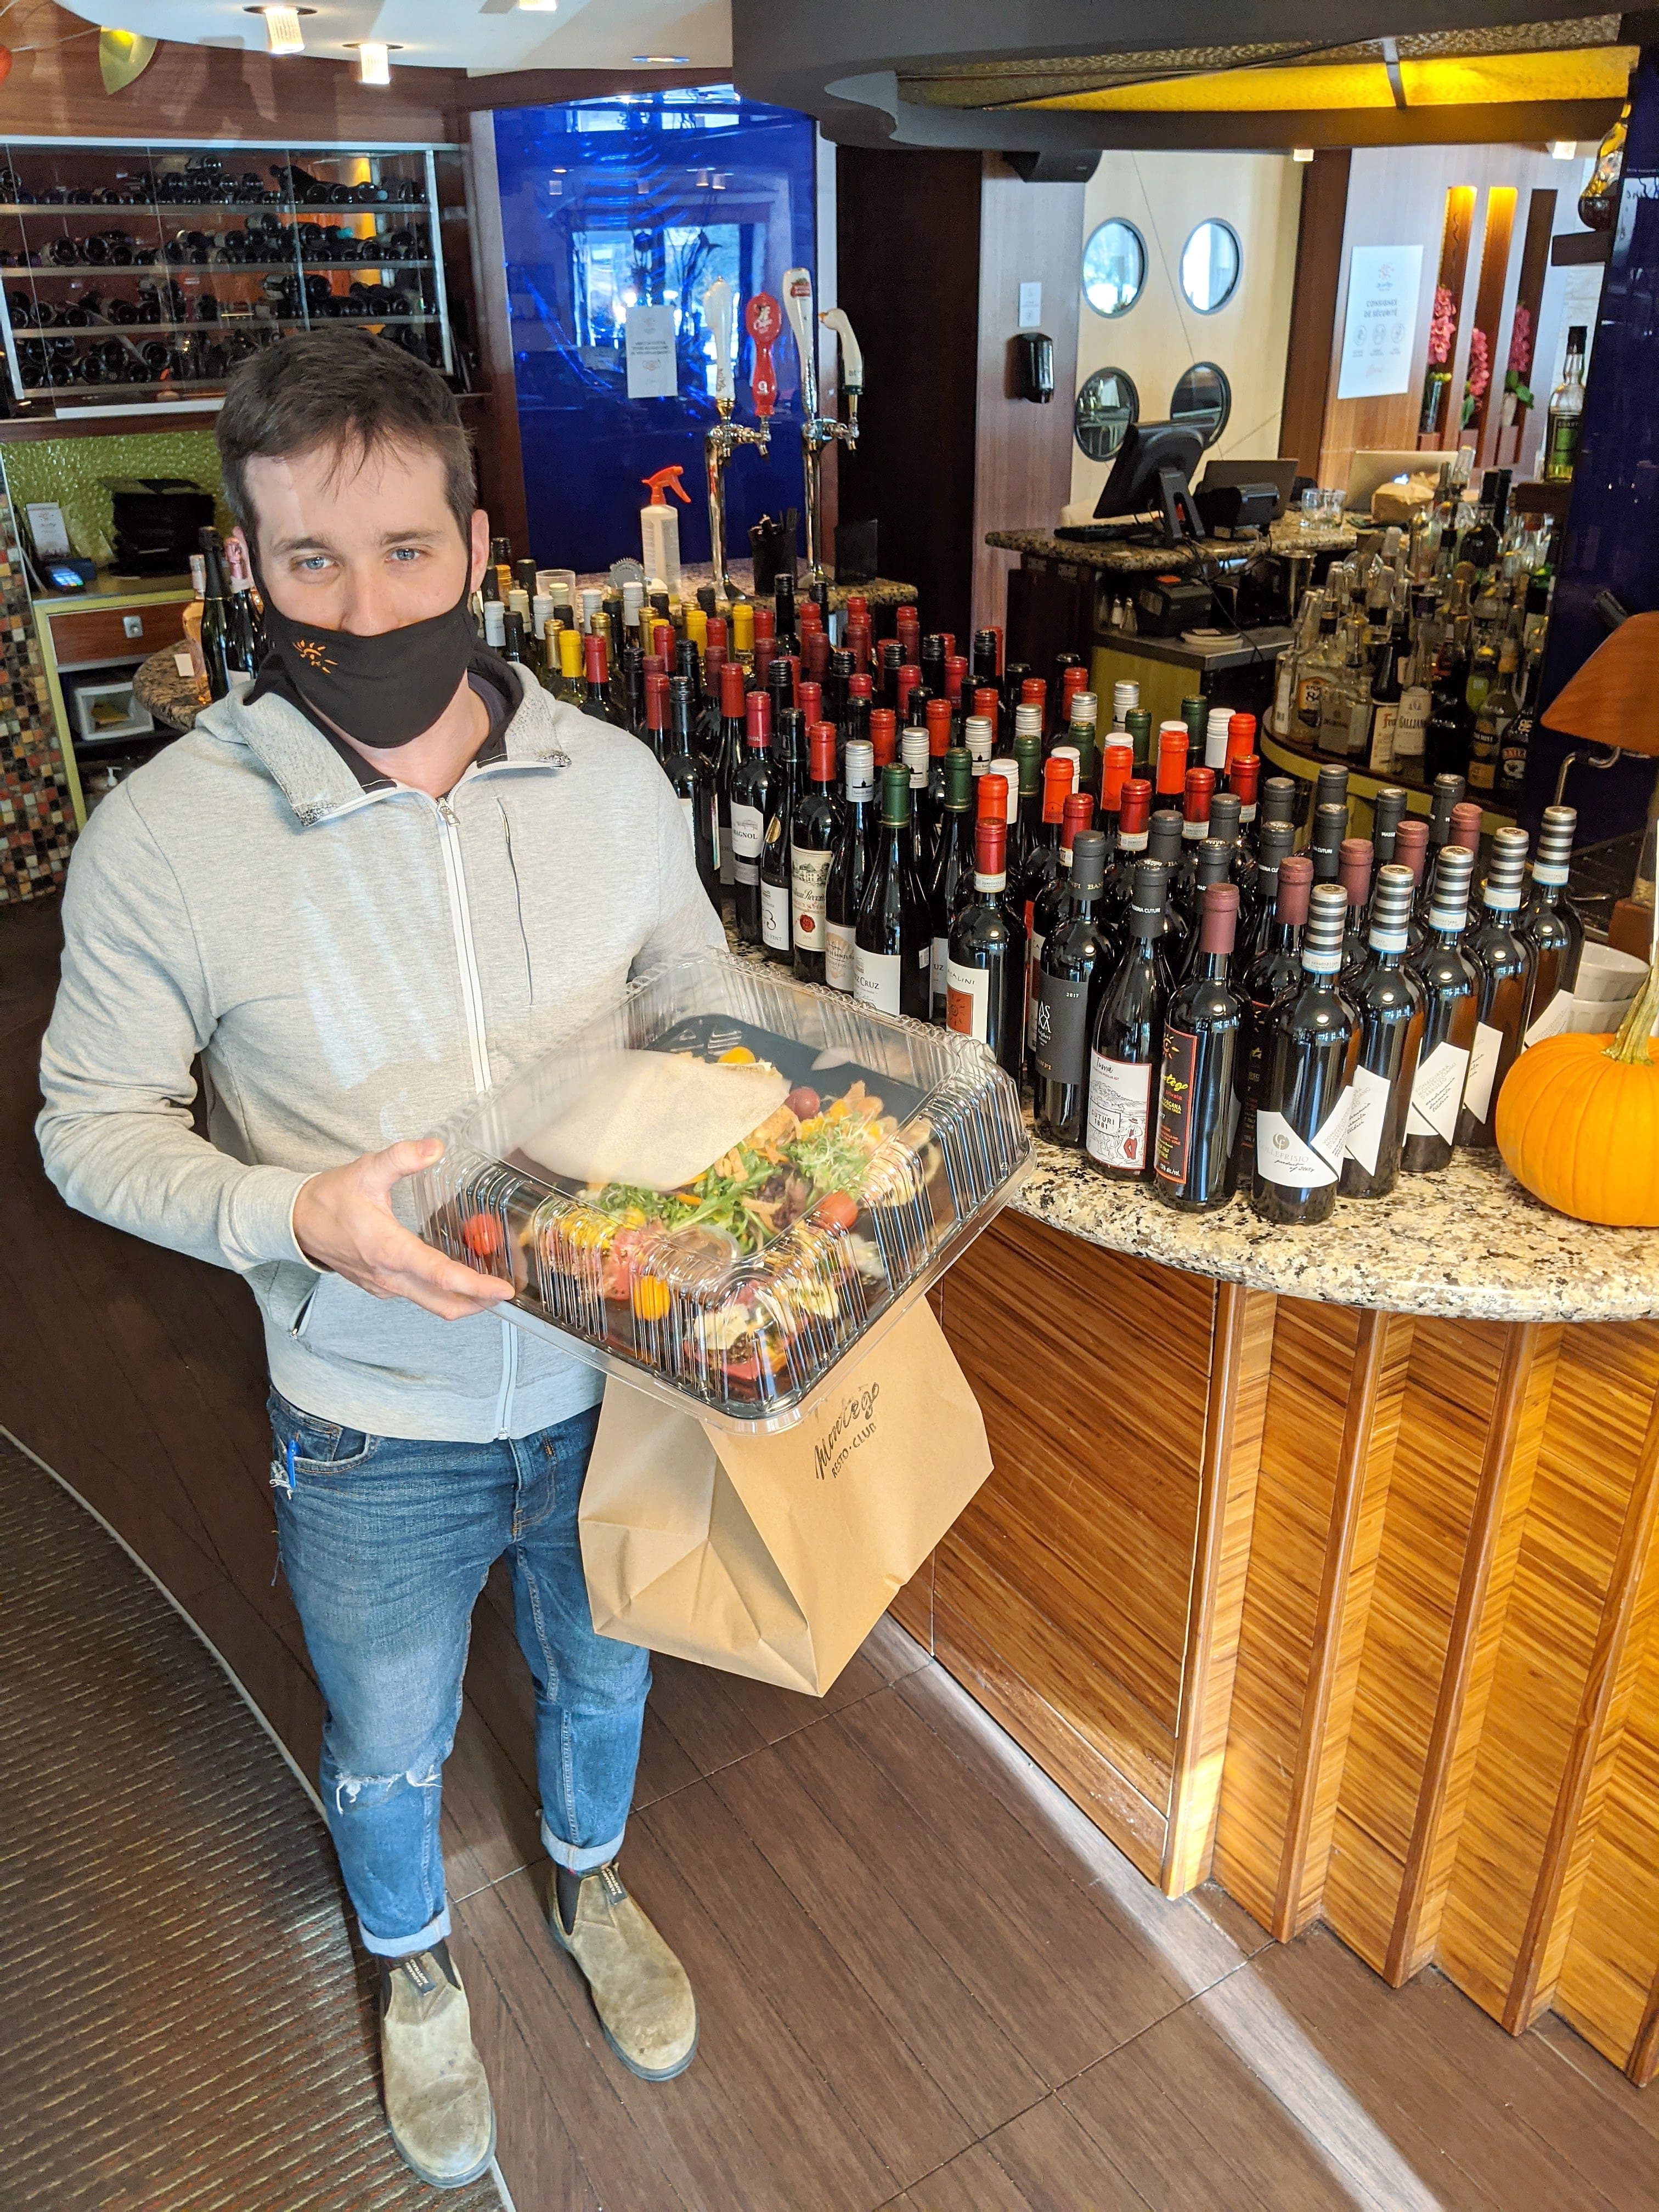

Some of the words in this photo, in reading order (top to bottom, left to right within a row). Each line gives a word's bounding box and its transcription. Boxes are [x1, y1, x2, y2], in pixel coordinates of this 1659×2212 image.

[860, 977, 879, 989] CRUZ
[1091, 1110, 1115, 1125] CUTURI
[1094, 1118, 1108, 1130] 1881
[814, 1382, 879, 1480] Montego
[832, 1447, 849, 1478] RESTO
